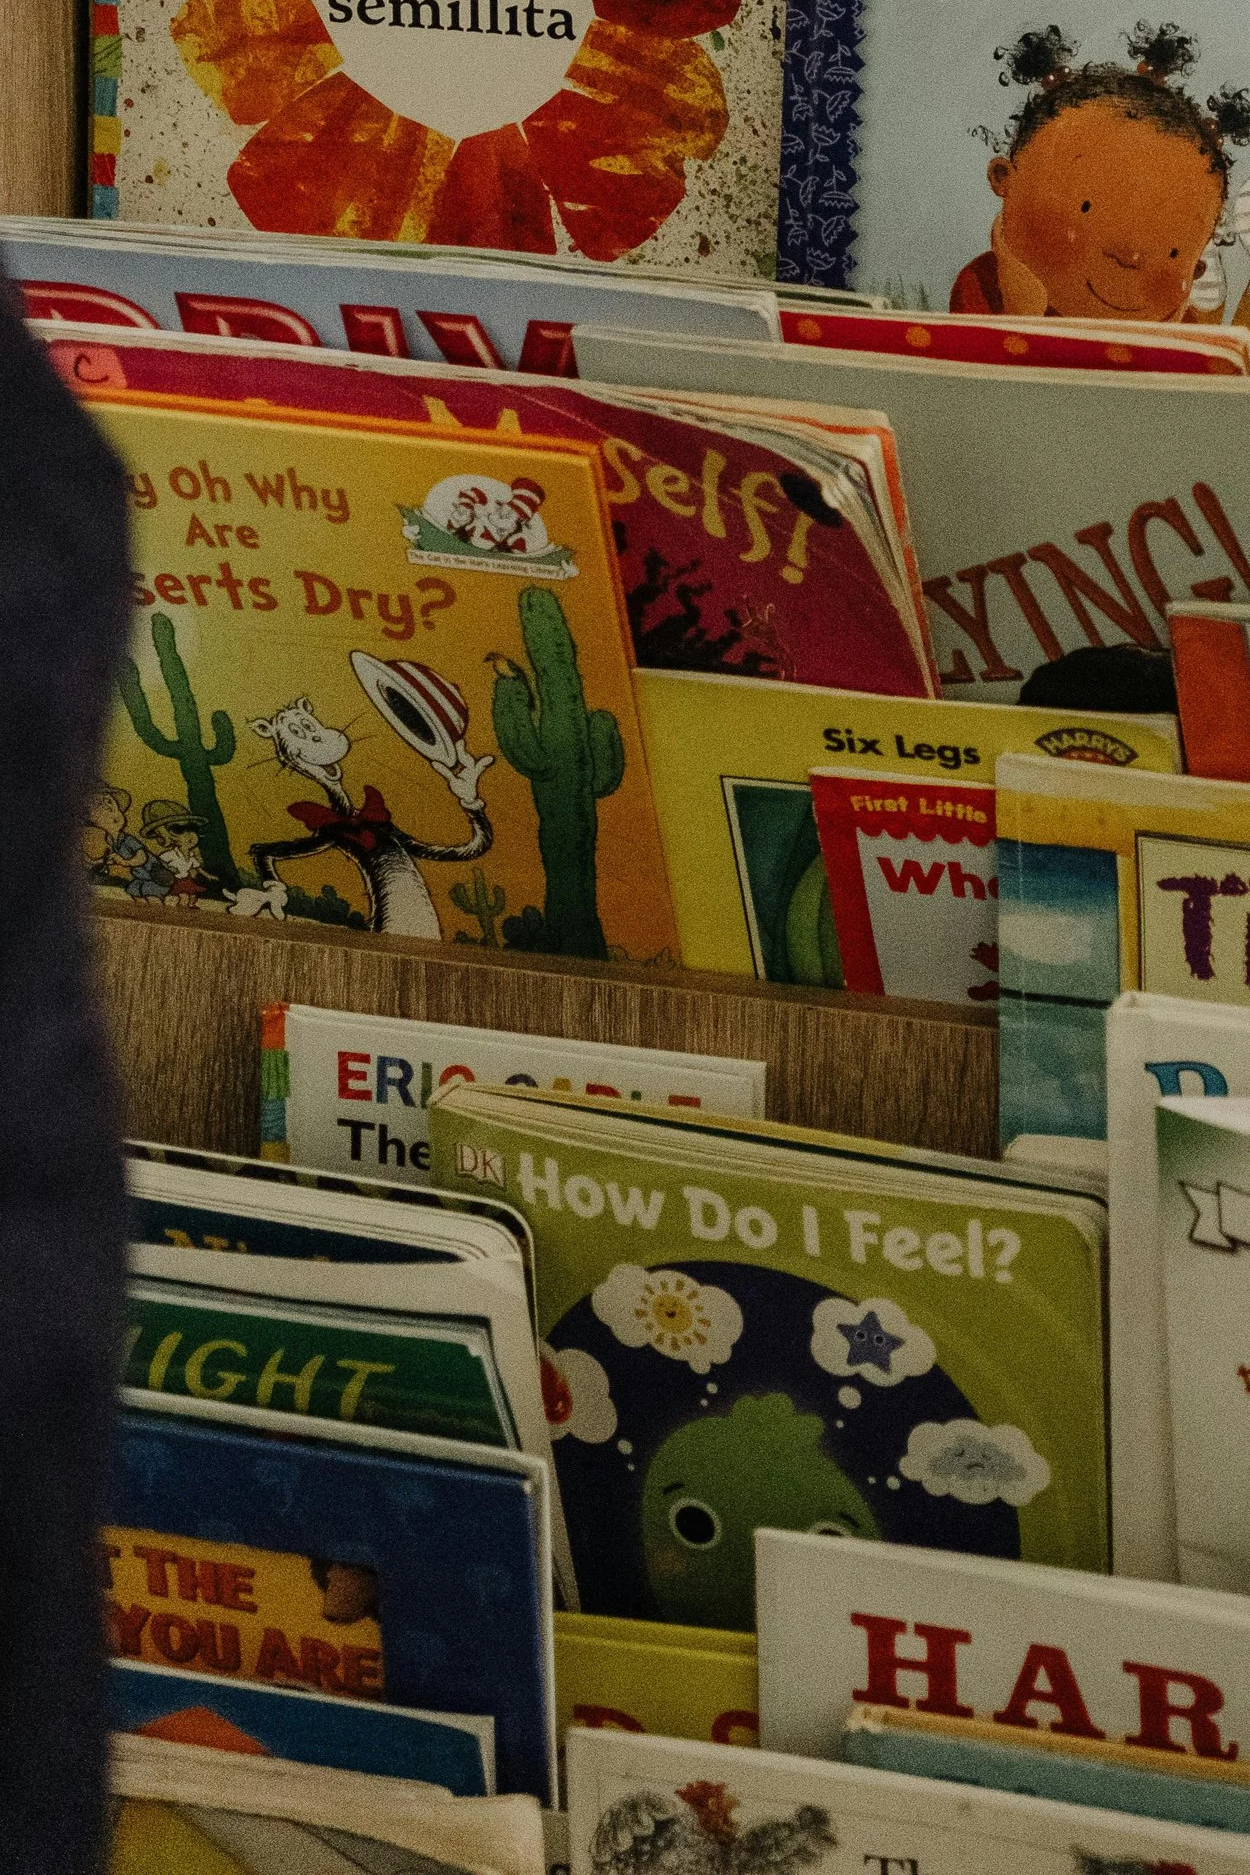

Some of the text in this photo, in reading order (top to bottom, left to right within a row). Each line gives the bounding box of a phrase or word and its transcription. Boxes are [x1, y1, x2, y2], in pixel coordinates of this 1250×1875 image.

[167, 459, 233, 504] Oh
[244, 466, 351, 524] Why
[184, 512, 261, 550] Are
[131, 561, 457, 640] serts Dry?
[822, 727, 982, 771] Six Legs
[849, 794, 988, 824] First Little
[876, 856, 999, 901] Wh
[336, 1118, 431, 1172] The
[455, 1144, 501, 1183] DK
[517, 1152, 1022, 1284] How Do I Feel?
[125, 1325, 396, 1422] IGHT
[132, 1543, 258, 1614] THE
[106, 1601, 384, 1702] YOU ARE
